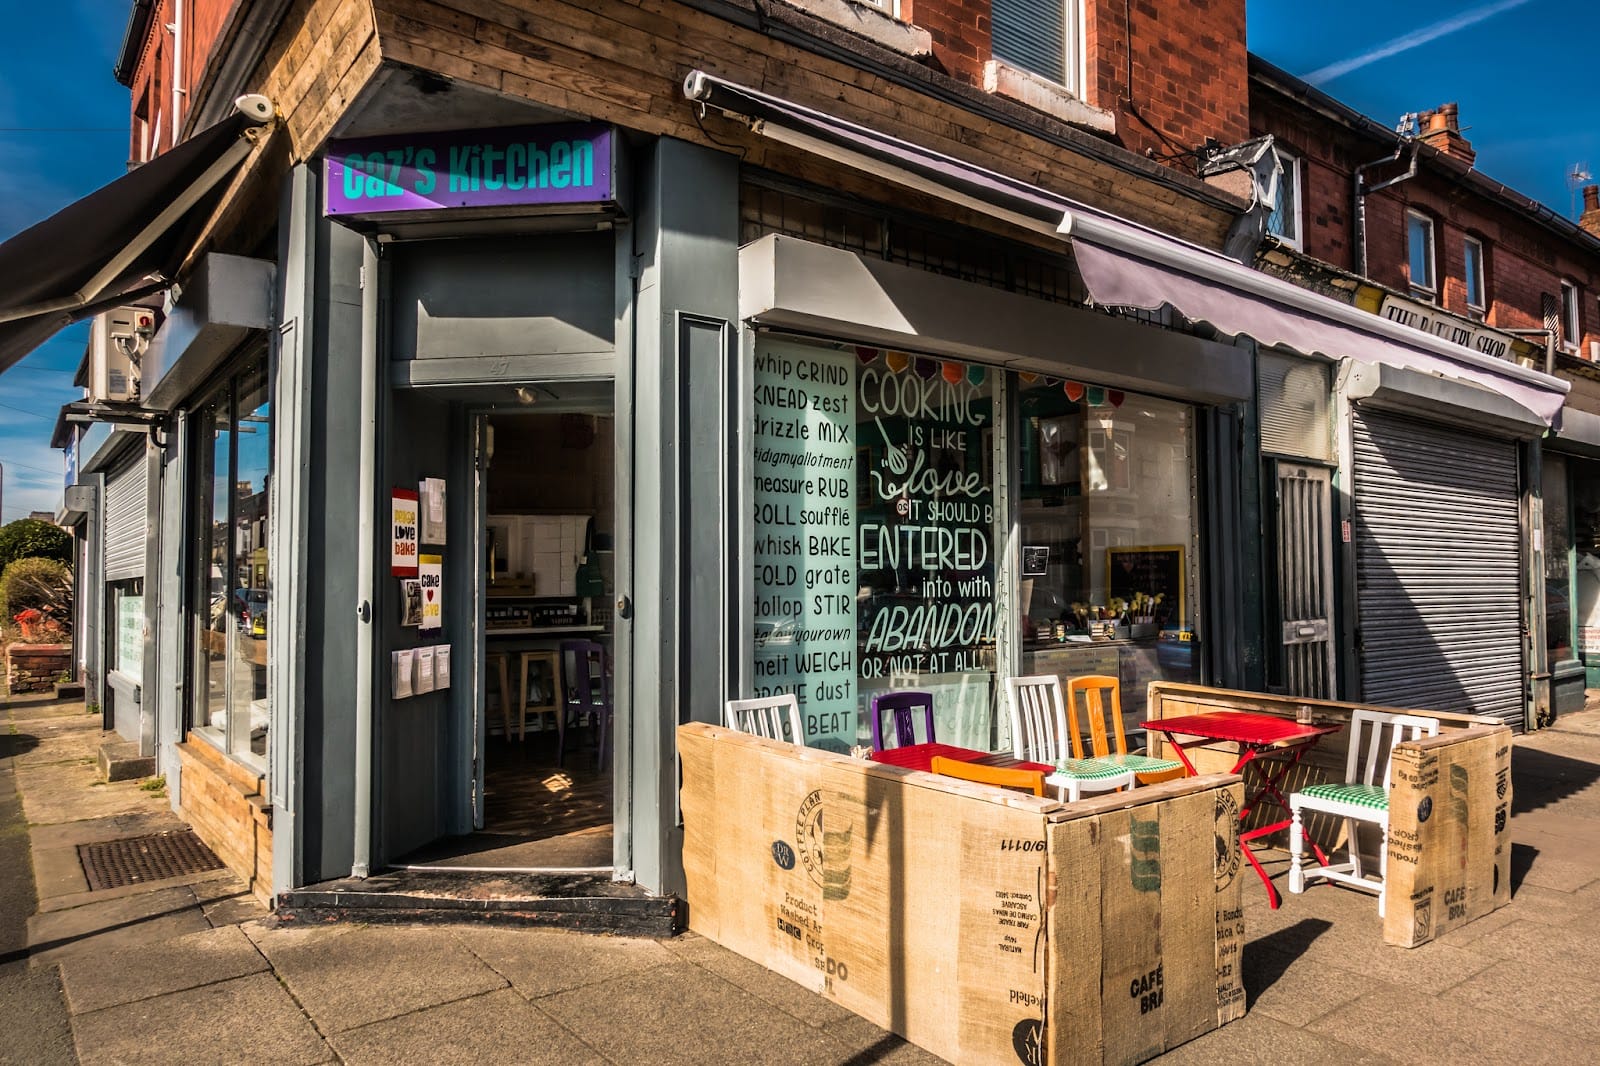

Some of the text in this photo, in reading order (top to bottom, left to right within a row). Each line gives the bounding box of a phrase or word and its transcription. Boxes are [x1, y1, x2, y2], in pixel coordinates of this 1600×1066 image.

[796, 360, 849, 386] GRIND
[812, 394, 849, 414] zest
[861, 368, 987, 426] COOKING
[818, 422, 849, 444] MIX
[910, 425, 967, 451] IS LIKE
[870, 449, 991, 500] love
[818, 477, 849, 498] RUB
[908, 499, 922, 521] IT
[927, 502, 981, 523] SHOULD
[809, 535, 851, 557] BAKE
[860, 524, 988, 571] ENTERED
[805, 565, 850, 589] grate
[922, 576, 991, 598] into with
[814, 594, 851, 615] STIR
[865, 602, 997, 653] ABANDON
[795, 650, 851, 674] WEIGH
[861, 657, 883, 680] OR
[889, 653, 924, 677] NOT
[930, 652, 950, 674] AT
[815, 679, 850, 702] dust
[808, 711, 851, 736] BEAT
[780, 904, 810, 928] Washed
[785, 892, 817, 917] Product
